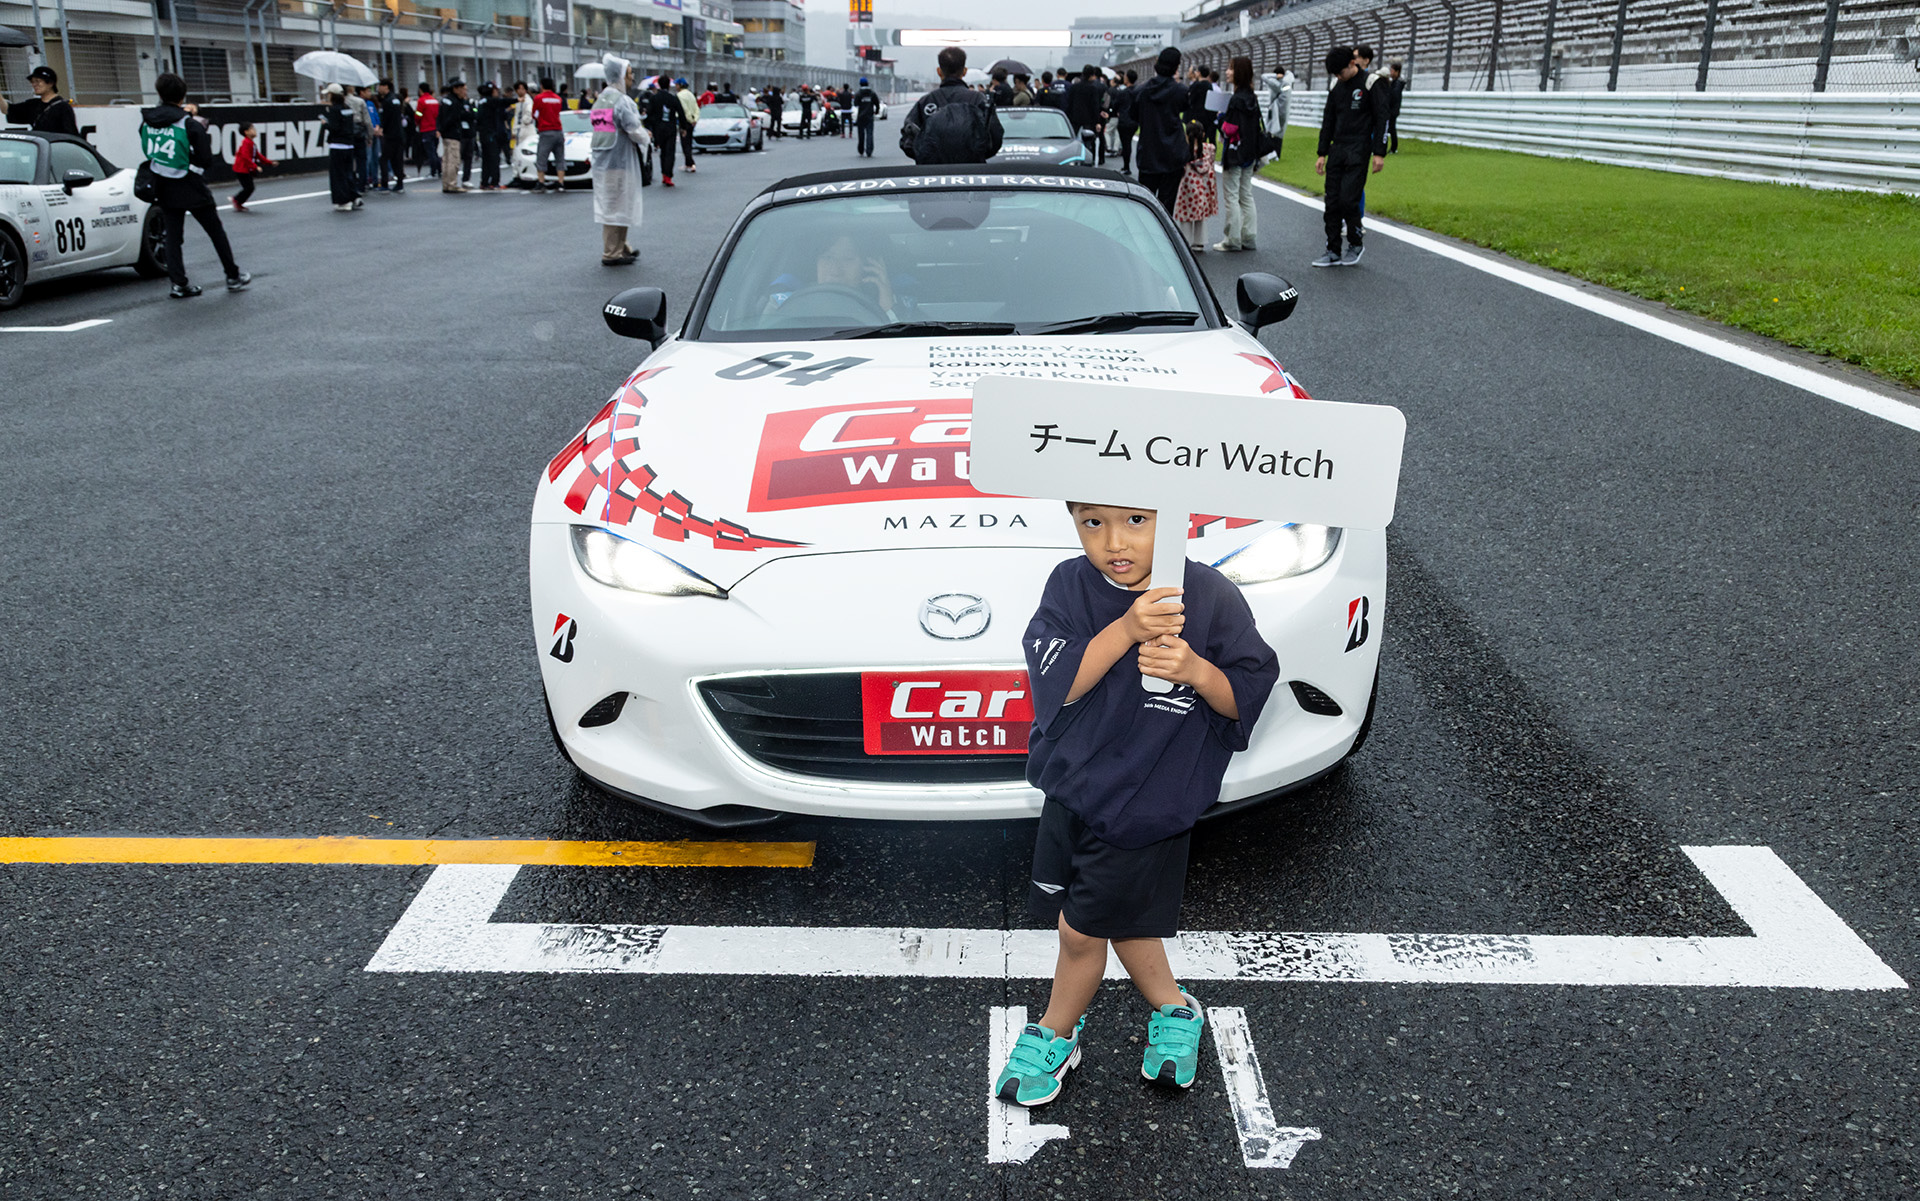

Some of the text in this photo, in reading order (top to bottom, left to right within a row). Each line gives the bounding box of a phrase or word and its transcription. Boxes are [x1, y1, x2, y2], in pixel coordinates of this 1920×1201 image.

[796, 175, 1106, 198] MAZDA SPIRIT RACING
[55, 216, 86, 254] 813
[604, 304, 627, 317] KTEL
[929, 344, 1138, 355] Kusakabe Yasuo
[929, 351, 1146, 363] Ishikawa Kazuya
[714, 350, 875, 387] 64
[929, 360, 1178, 375] Kobayashi Takashi
[1051, 370, 1130, 383] Kouki
[799, 406, 973, 453] Ca
[1030, 423, 1335, 480] チーム Car Watch
[842, 451, 971, 486] Wat
[883, 513, 1029, 531] MAZDA
[889, 681, 1026, 719] Car
[910, 725, 1007, 747] Watch
